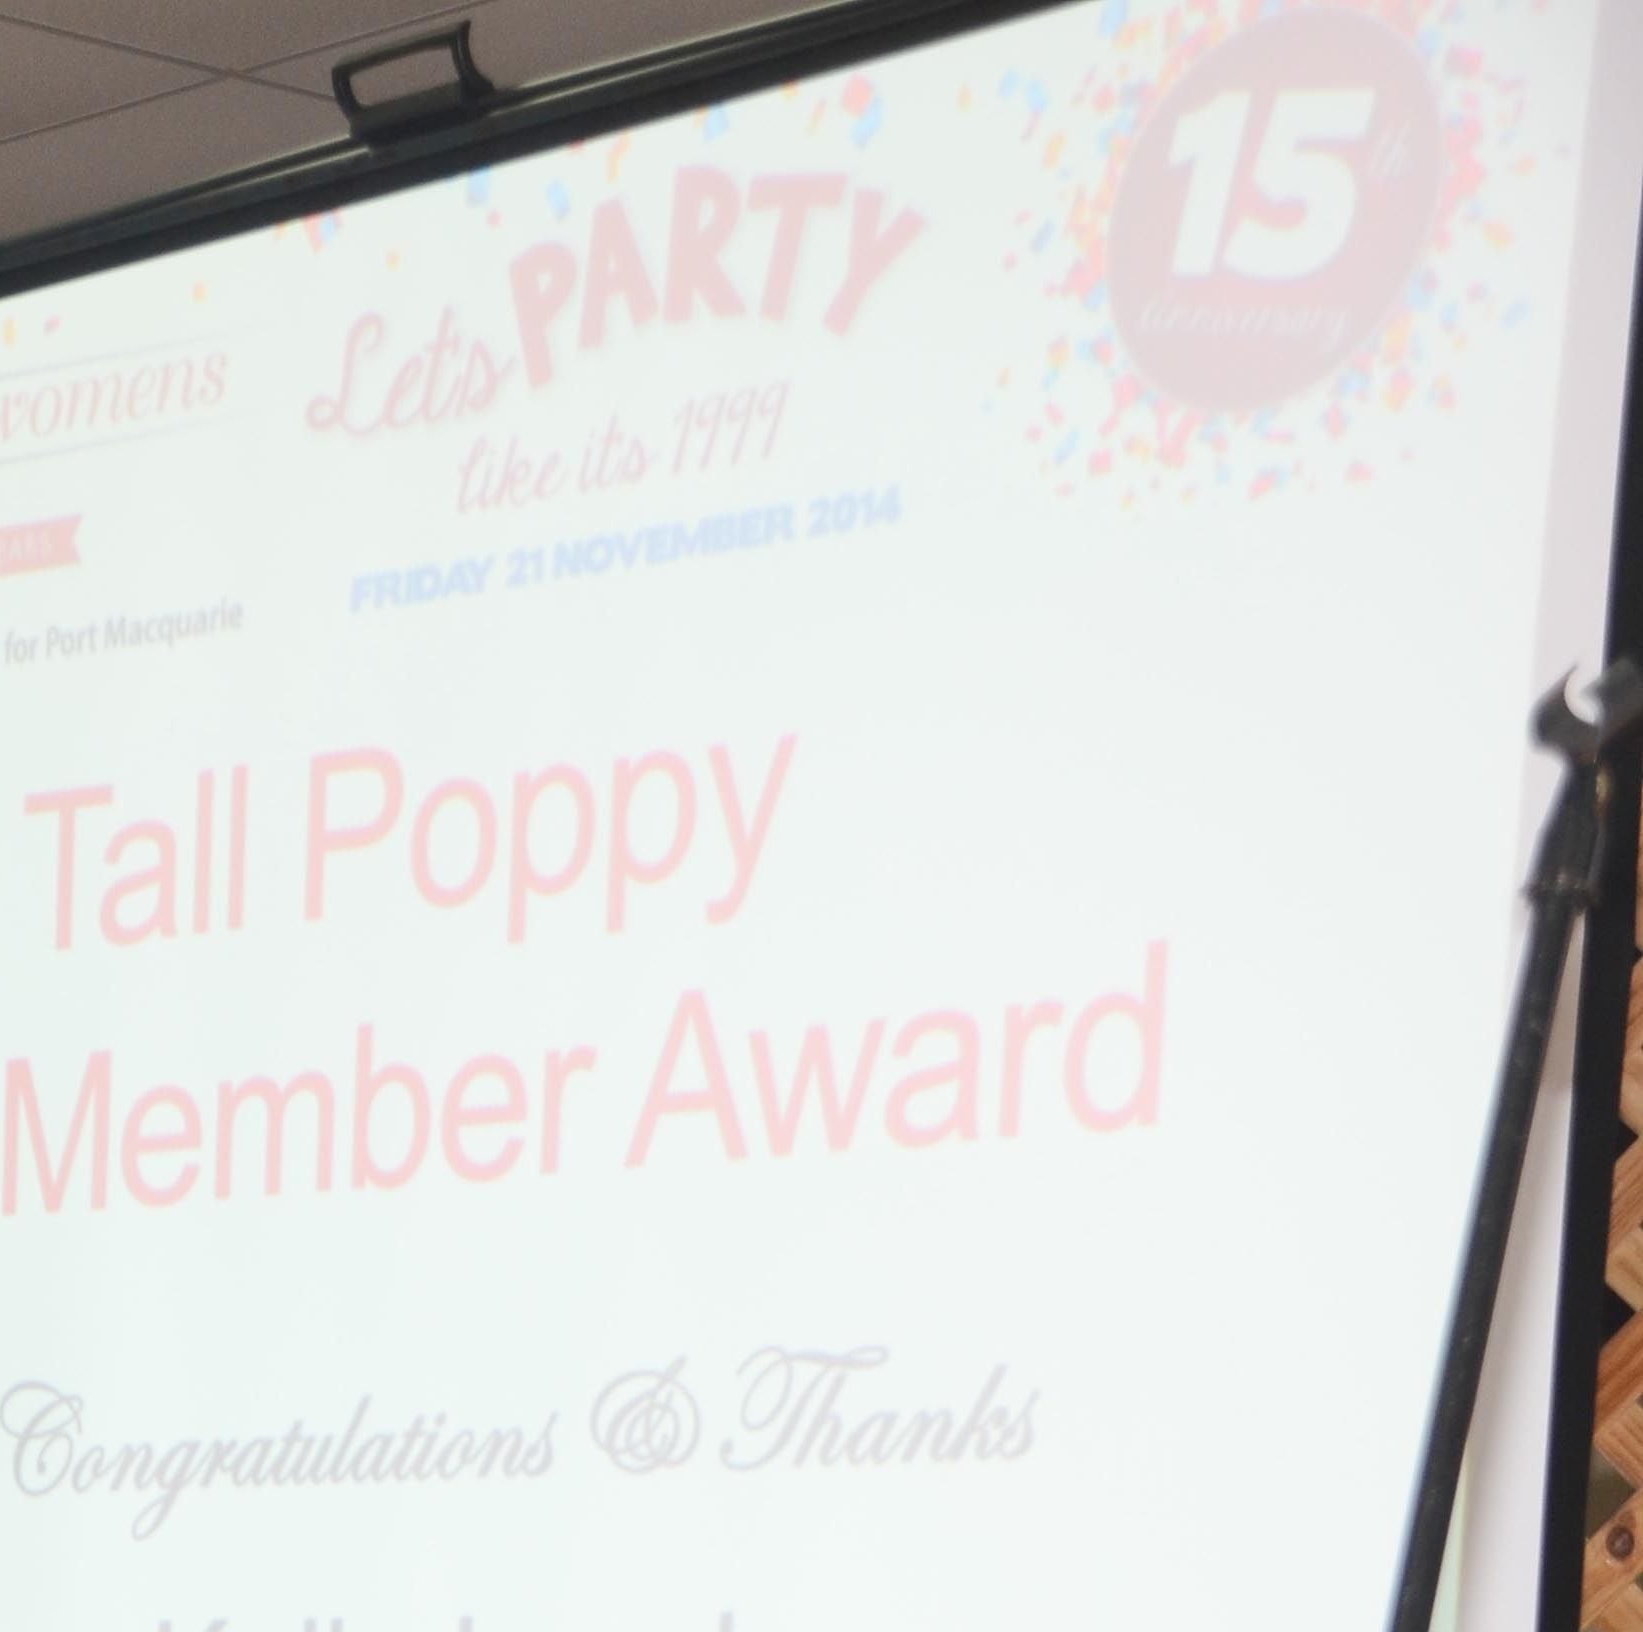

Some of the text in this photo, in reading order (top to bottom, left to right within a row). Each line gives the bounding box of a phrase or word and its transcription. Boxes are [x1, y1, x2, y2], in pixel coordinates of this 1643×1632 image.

[508, 165, 926, 389] PARTY
[457, 420, 569, 514] like
[667, 378, 790, 474] 1999
[349, 486, 902, 614] FRIDAY 21 NOVEMBER 2014
[4, 628, 37, 665] for
[46, 622, 99, 660] Port
[104, 597, 244, 649] Macquarie
[24, 734, 798, 950] Tall Poppy
[1, 1022, 598, 1217] Member
[622, 937, 1171, 1172] Award
[718, 1344, 1042, 1471] Thanks
